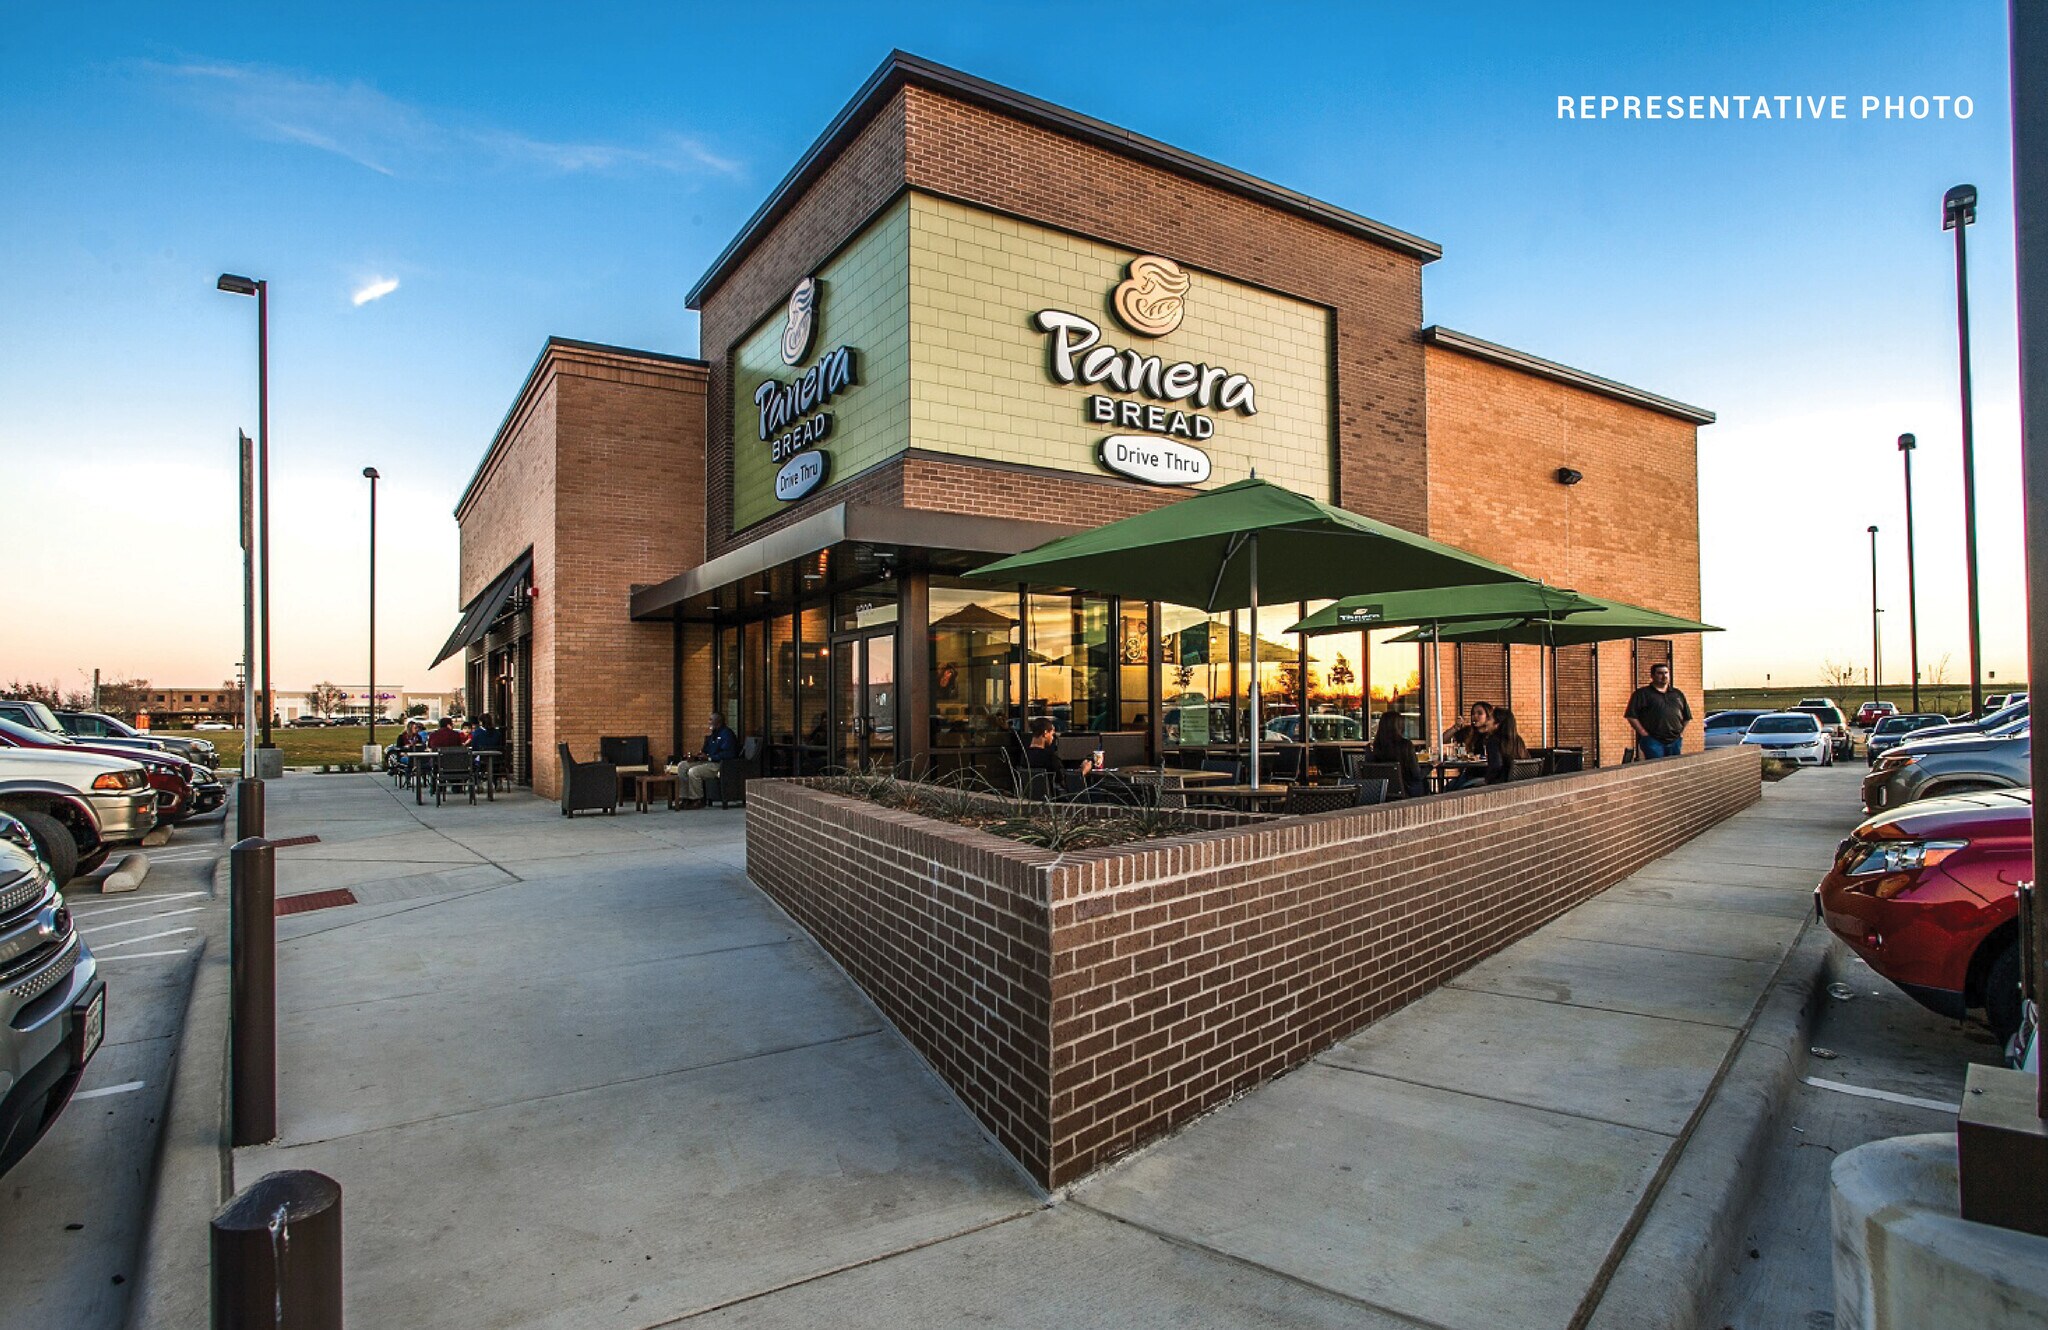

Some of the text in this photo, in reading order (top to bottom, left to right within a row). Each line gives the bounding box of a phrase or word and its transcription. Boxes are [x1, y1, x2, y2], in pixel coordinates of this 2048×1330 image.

[1035, 309, 1257, 415] Panera
[755, 346, 854, 440] Panera
[772, 414, 828, 463] BREAD
[1092, 396, 1214, 440] BREAD
[779, 463, 818, 492] Drive Thru
[1116, 444, 1200, 473] Drive Thru
